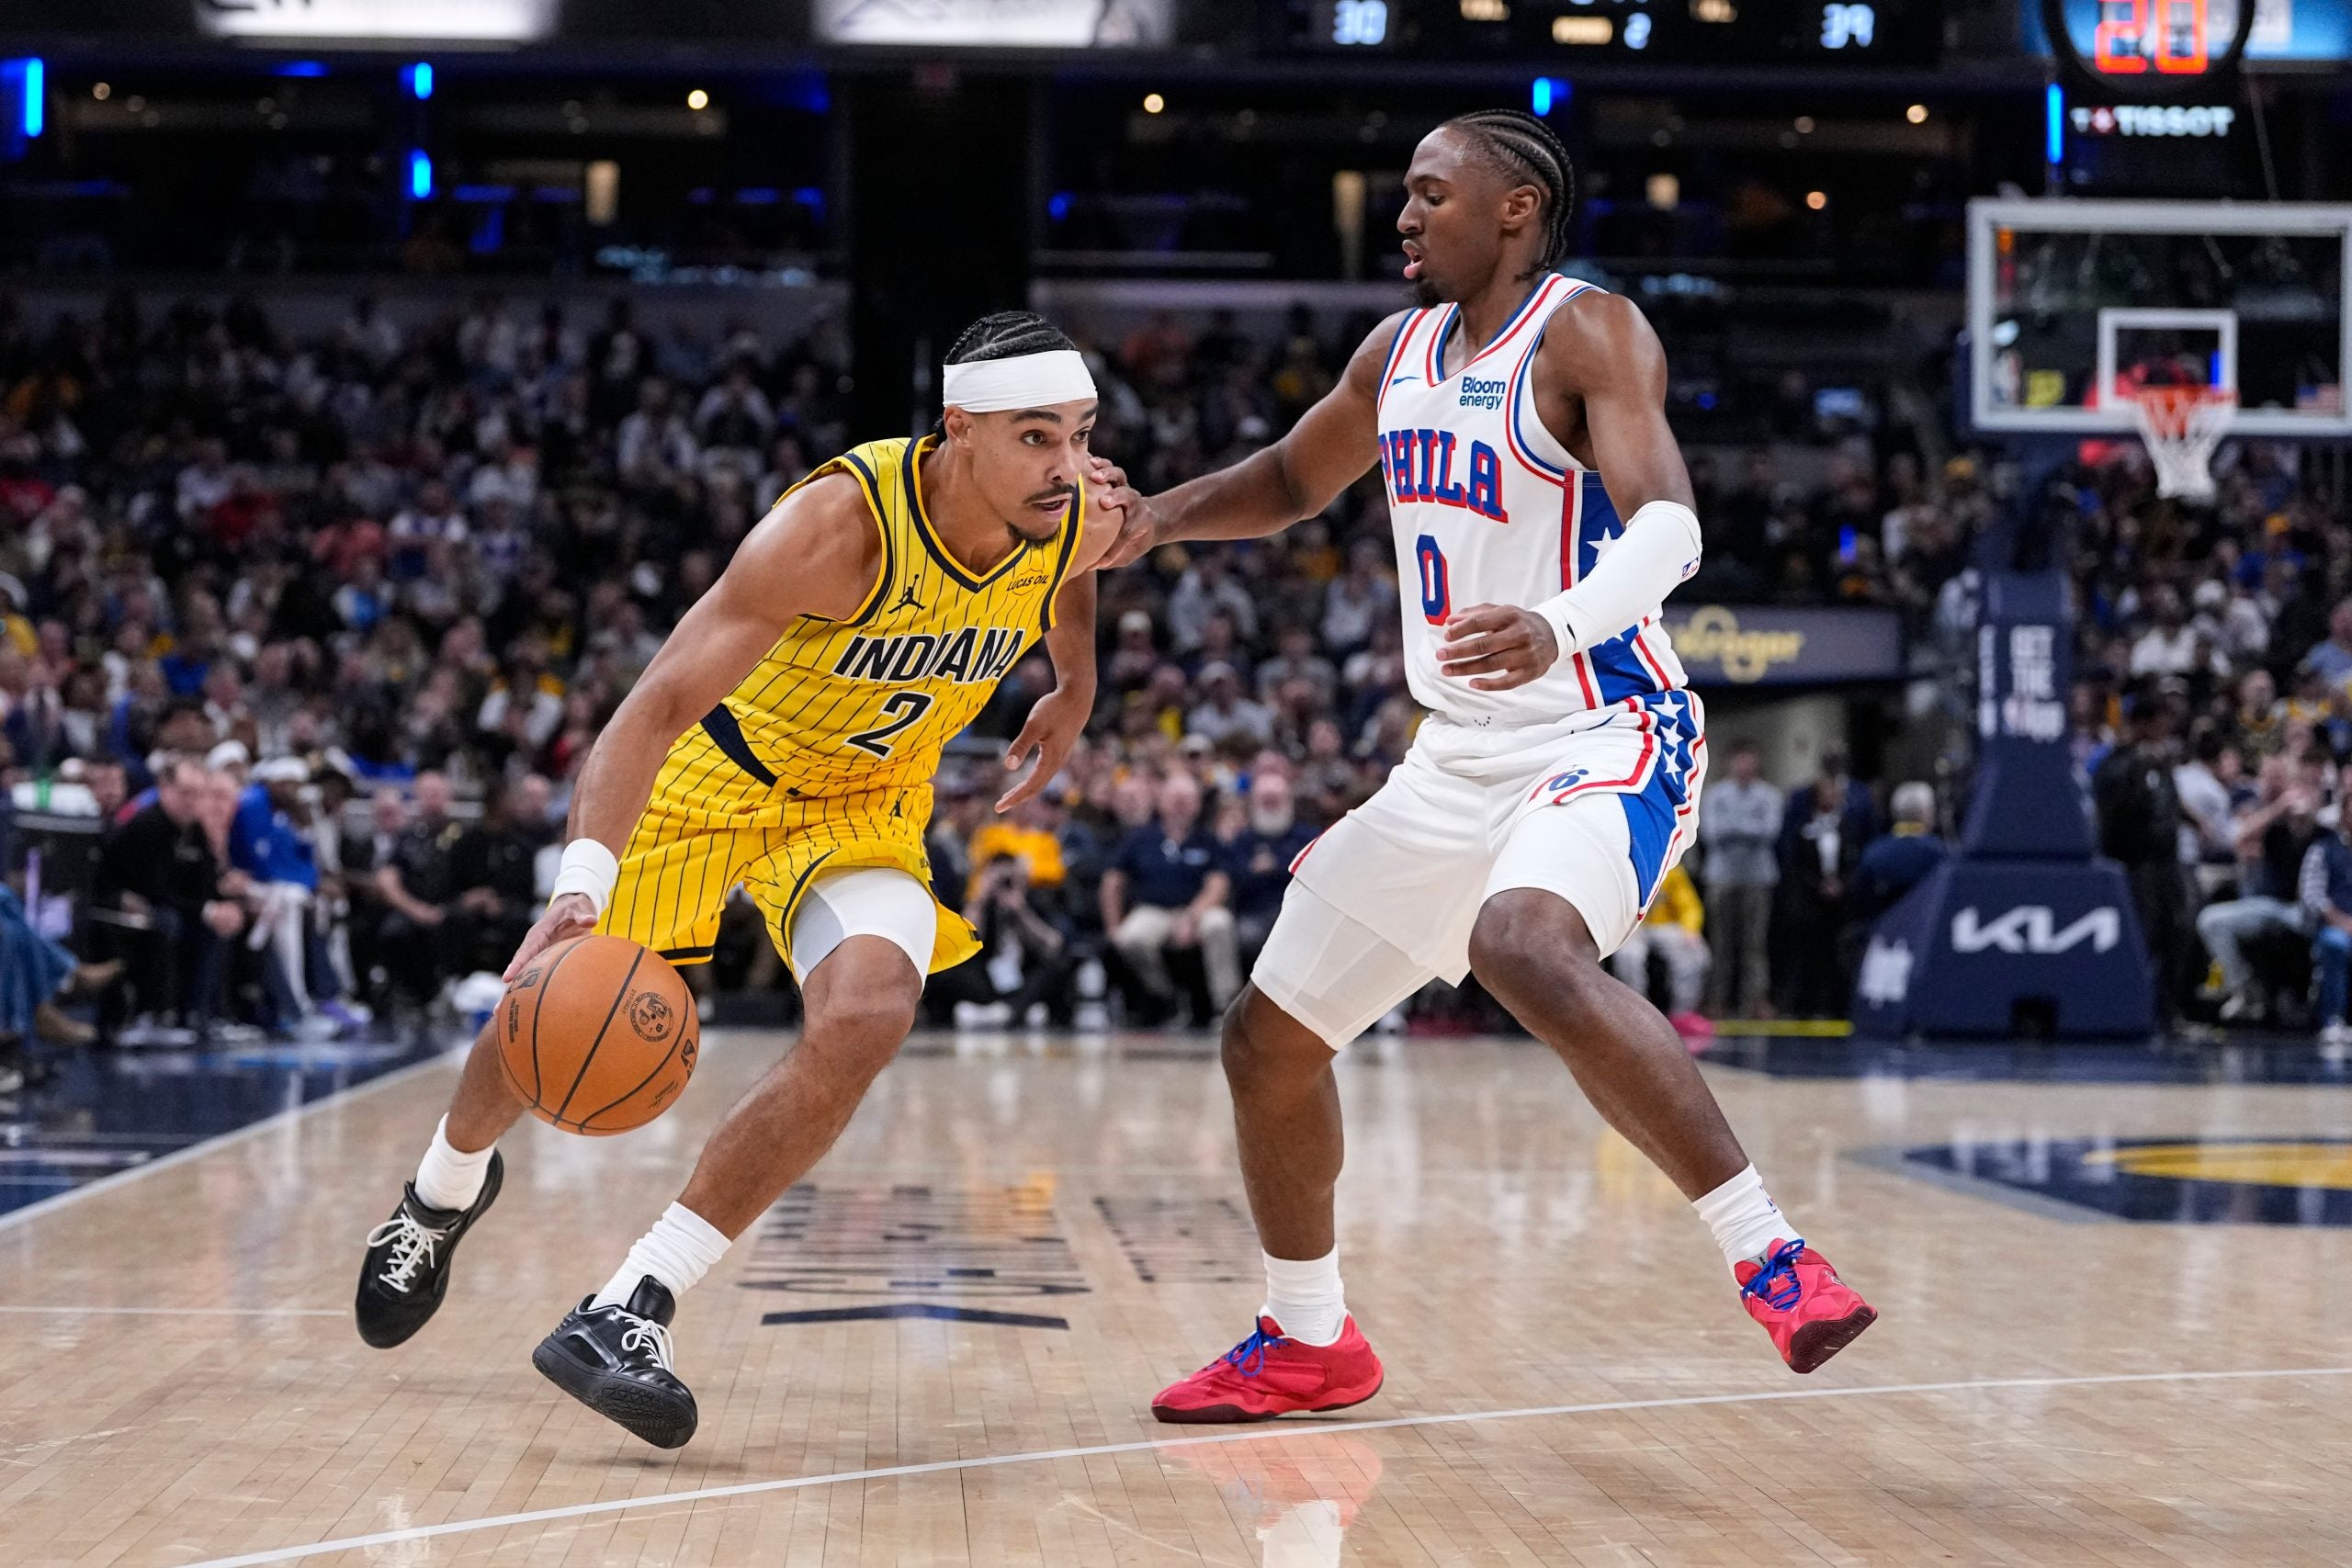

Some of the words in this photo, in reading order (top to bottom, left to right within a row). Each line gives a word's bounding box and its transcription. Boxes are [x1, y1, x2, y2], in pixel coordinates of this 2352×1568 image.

[2095, 0, 2208, 73] 20
[2115, 106, 2234, 136] TISSOT
[1460, 395, 1503, 410] energy
[1462, 377, 1506, 393] Bloom
[1006, 576, 1034, 592] LUCAS
[1034, 574, 1049, 585] OIL
[1416, 534, 1451, 626] 0
[833, 627, 1025, 683] INDIANA
[843, 691, 933, 760] 2
